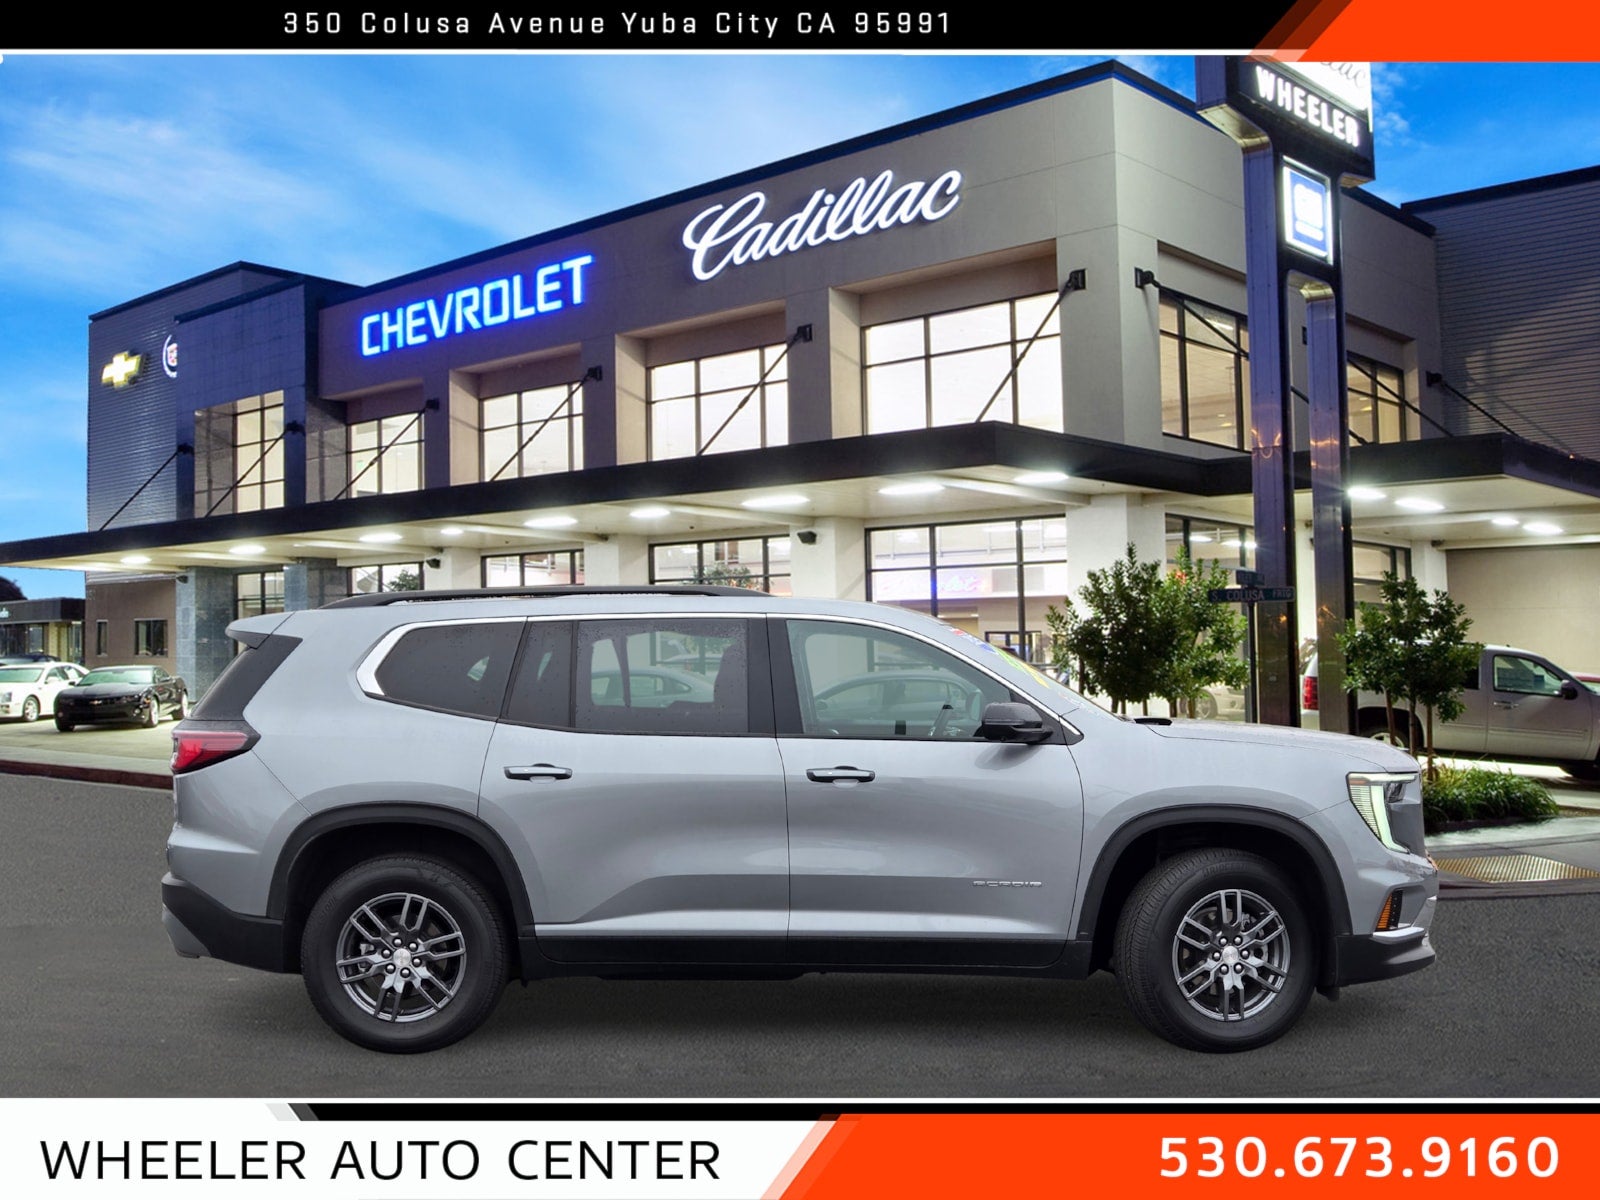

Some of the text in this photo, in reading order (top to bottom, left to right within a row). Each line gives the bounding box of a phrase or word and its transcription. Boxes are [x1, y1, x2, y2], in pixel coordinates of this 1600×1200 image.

[1255, 64, 1360, 148] WHEELER
[682, 169, 963, 282] Cadillac
[361, 255, 593, 357] CHEVROLET
[1226, 589, 1265, 601] COLUSA
